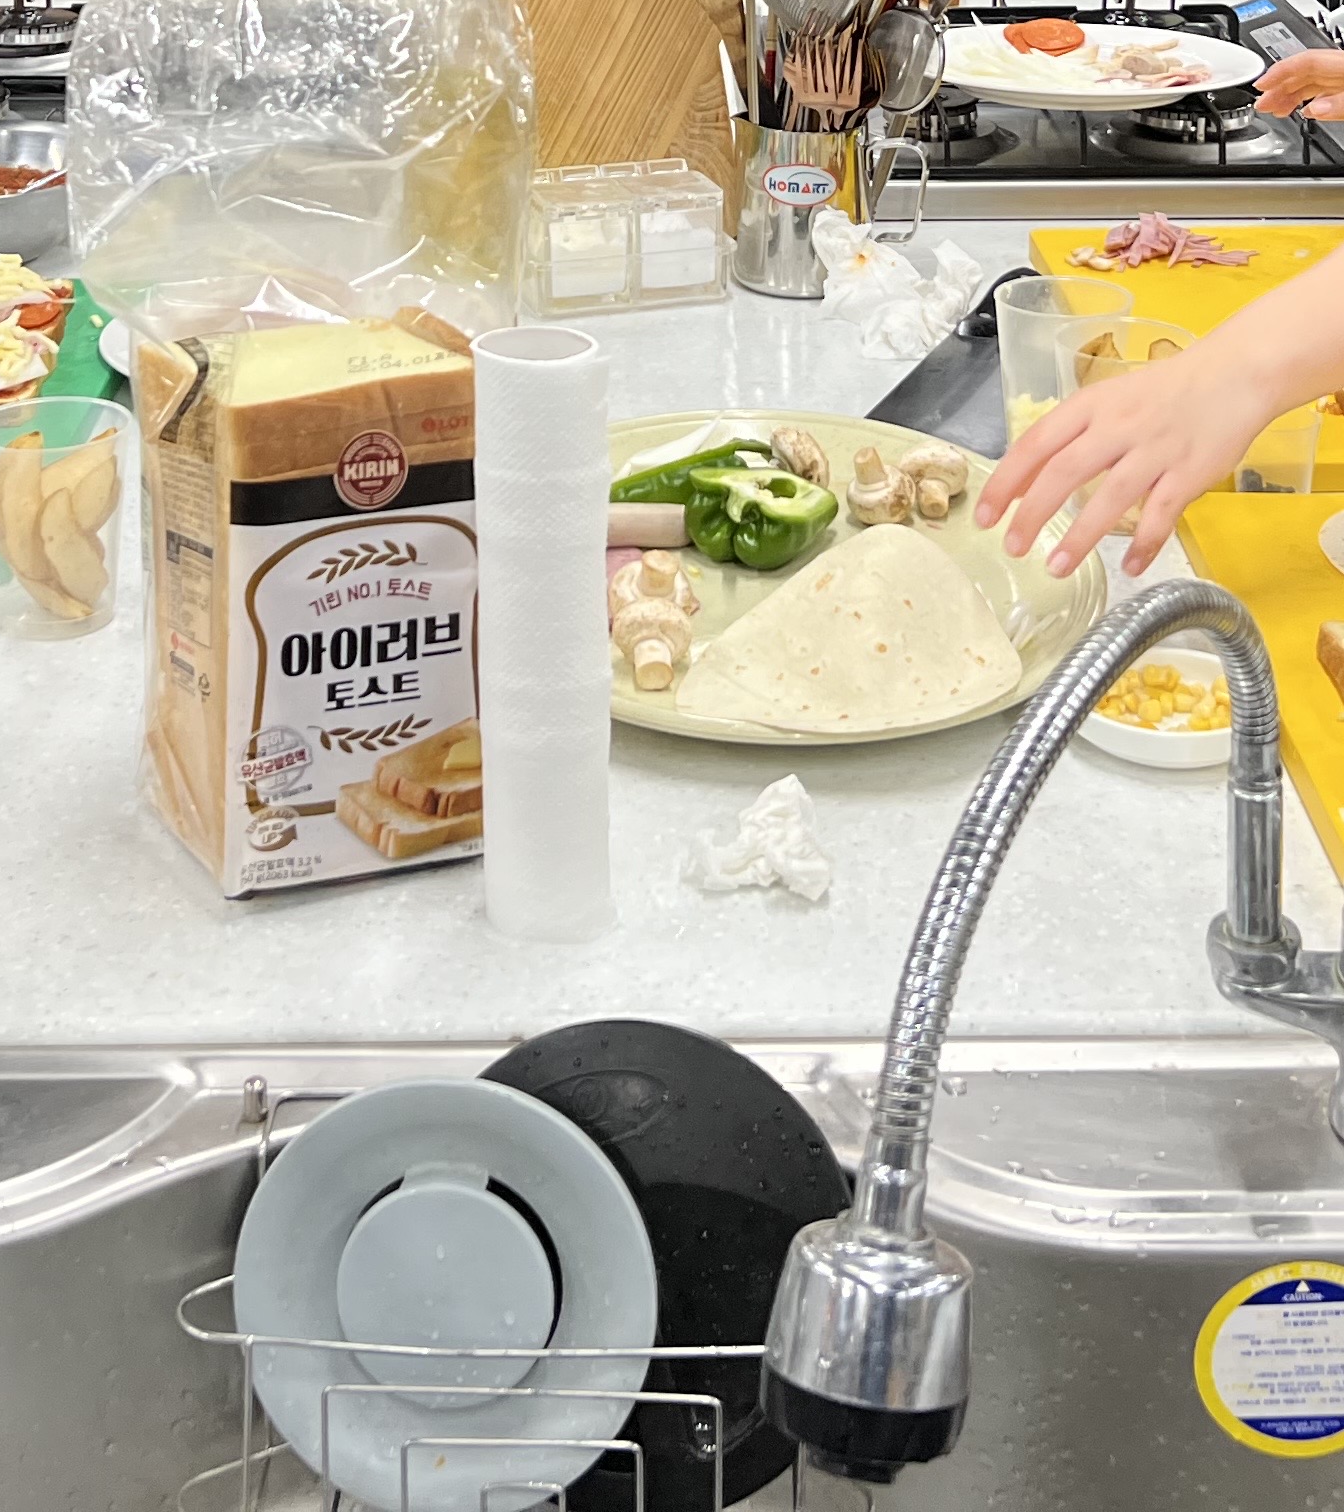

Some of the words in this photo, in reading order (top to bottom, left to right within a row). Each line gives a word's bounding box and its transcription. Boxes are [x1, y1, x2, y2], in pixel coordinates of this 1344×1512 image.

[343, 458, 400, 481] KIRIN
[309, 590, 343, 617] 기린
[347, 580, 382, 603] NO.1
[386, 578, 433, 601] 토스트
[281, 611, 463, 677] 아이러브
[324, 670, 422, 712] 토스트
